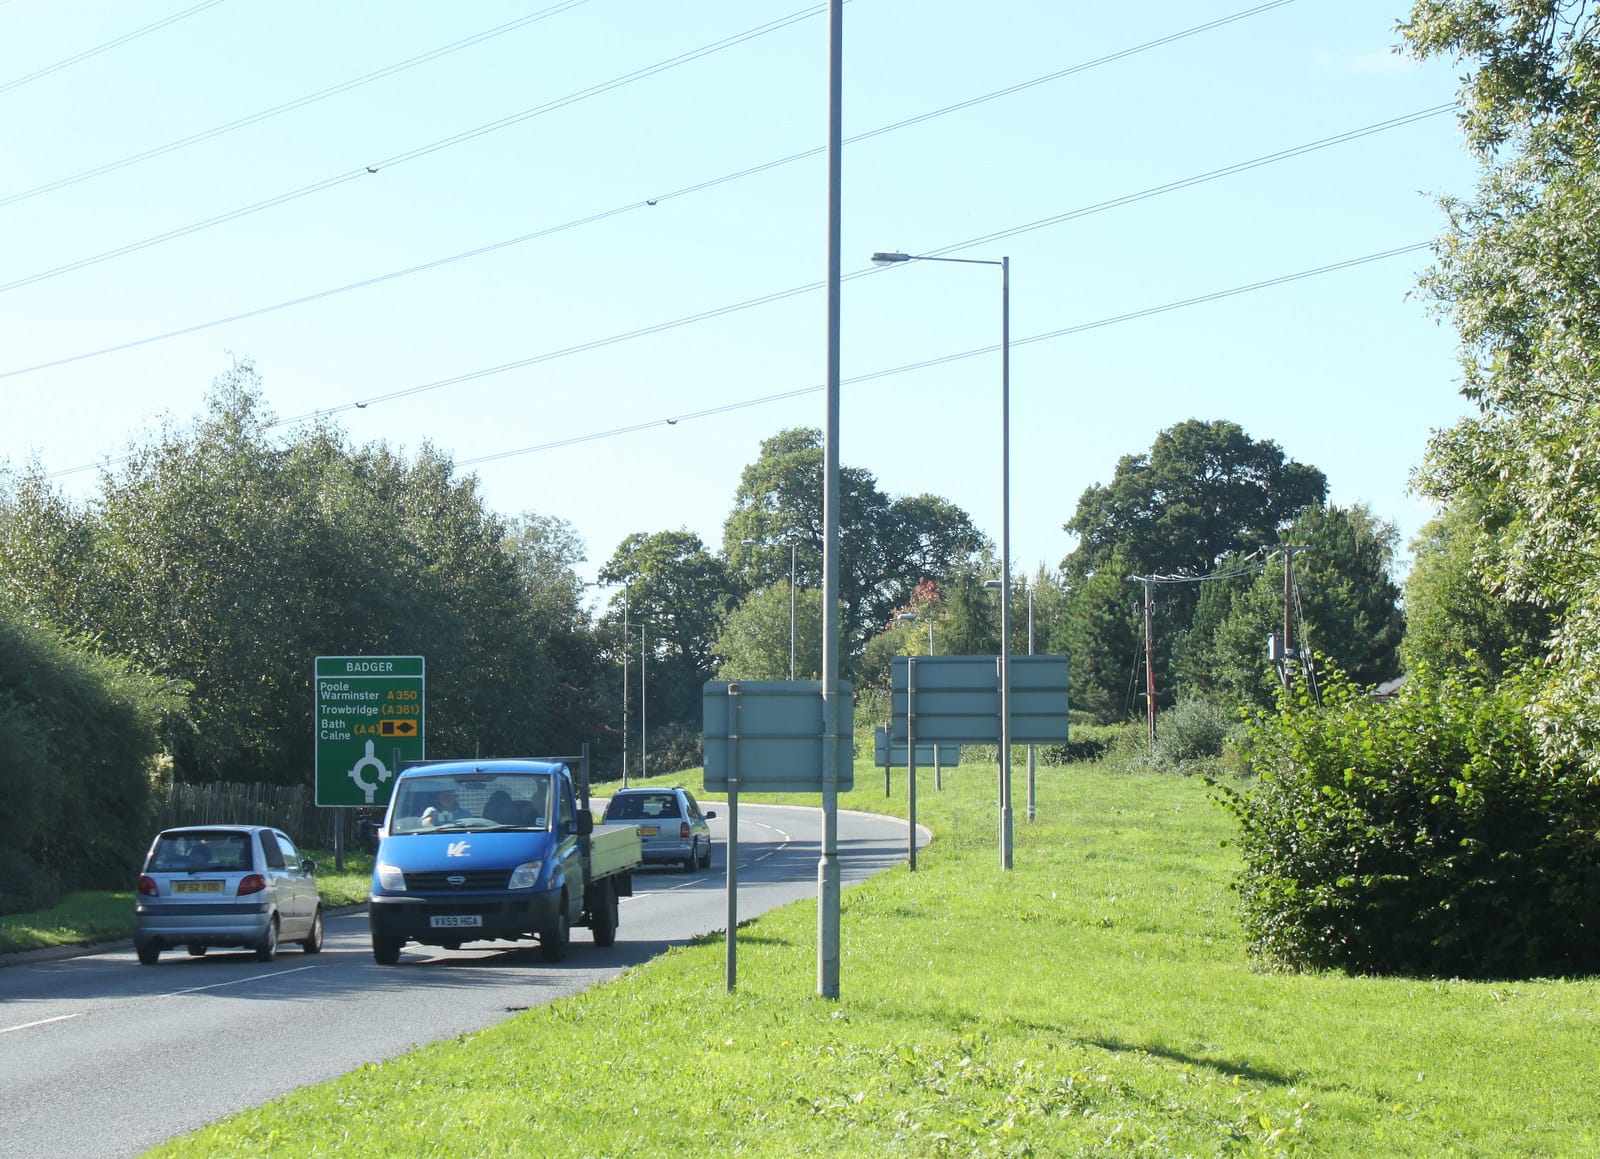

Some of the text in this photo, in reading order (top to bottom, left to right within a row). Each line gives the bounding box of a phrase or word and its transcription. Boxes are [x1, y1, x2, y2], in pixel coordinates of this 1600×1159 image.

[346, 662, 393, 672] BADGER
[320, 682, 349, 691] Poole
[321, 691, 379, 700] Warminster
[321, 704, 379, 716] Trowbridge
[321, 719, 346, 729] Bath
[320, 730, 351, 740] Calne
